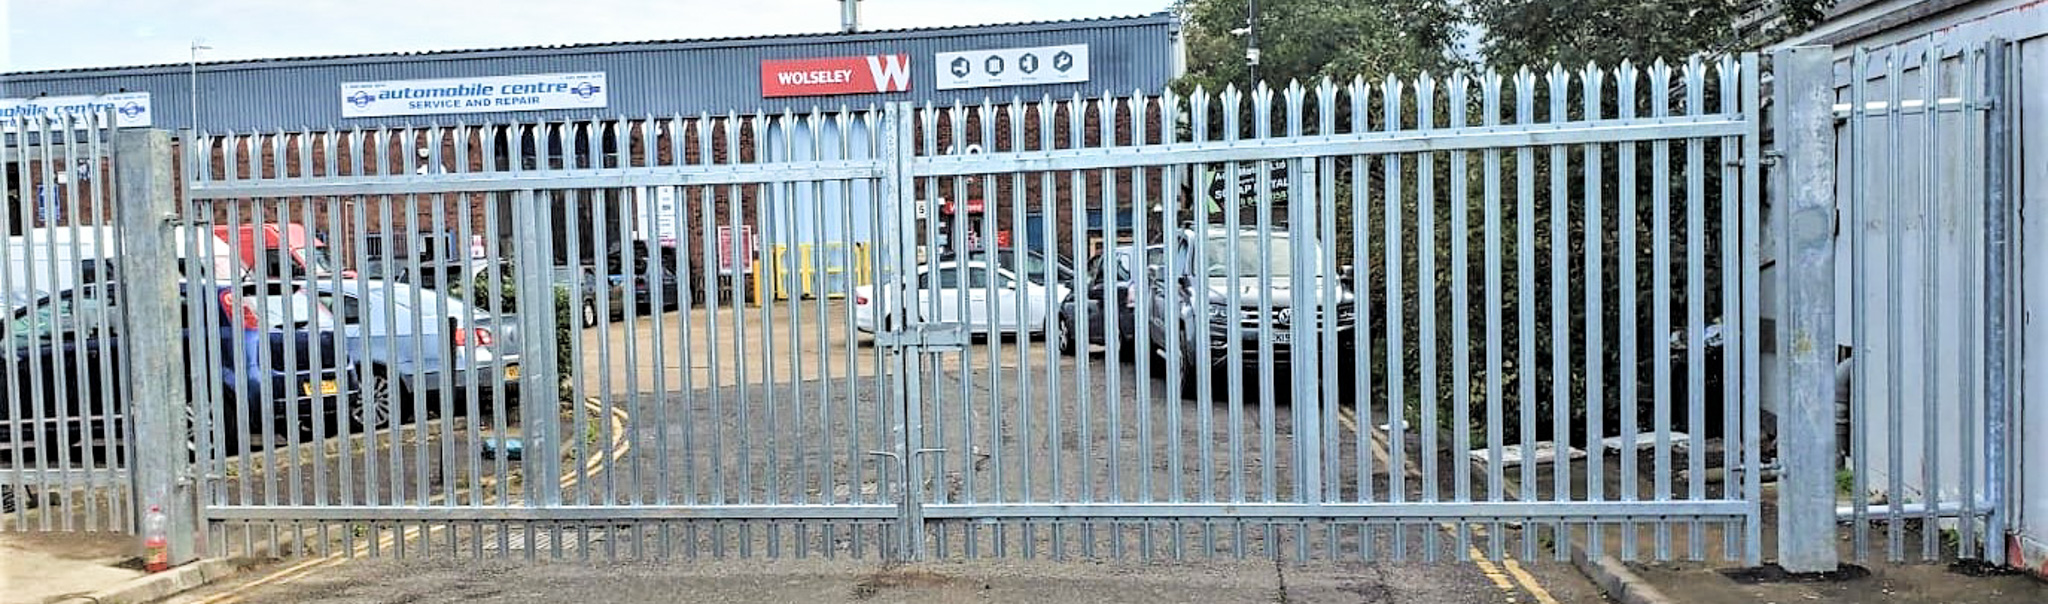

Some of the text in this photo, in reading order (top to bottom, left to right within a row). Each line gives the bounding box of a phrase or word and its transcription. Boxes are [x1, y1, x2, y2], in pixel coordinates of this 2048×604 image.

[777, 69, 852, 85] WOLSELEY
[866, 55, 910, 93] W
[378, 82, 568, 100] automobile centre
[0, 104, 48, 117] obile
[408, 96, 540, 109] SERVICE AND REPAIR
[1214, 183, 1253, 200] SCAP
